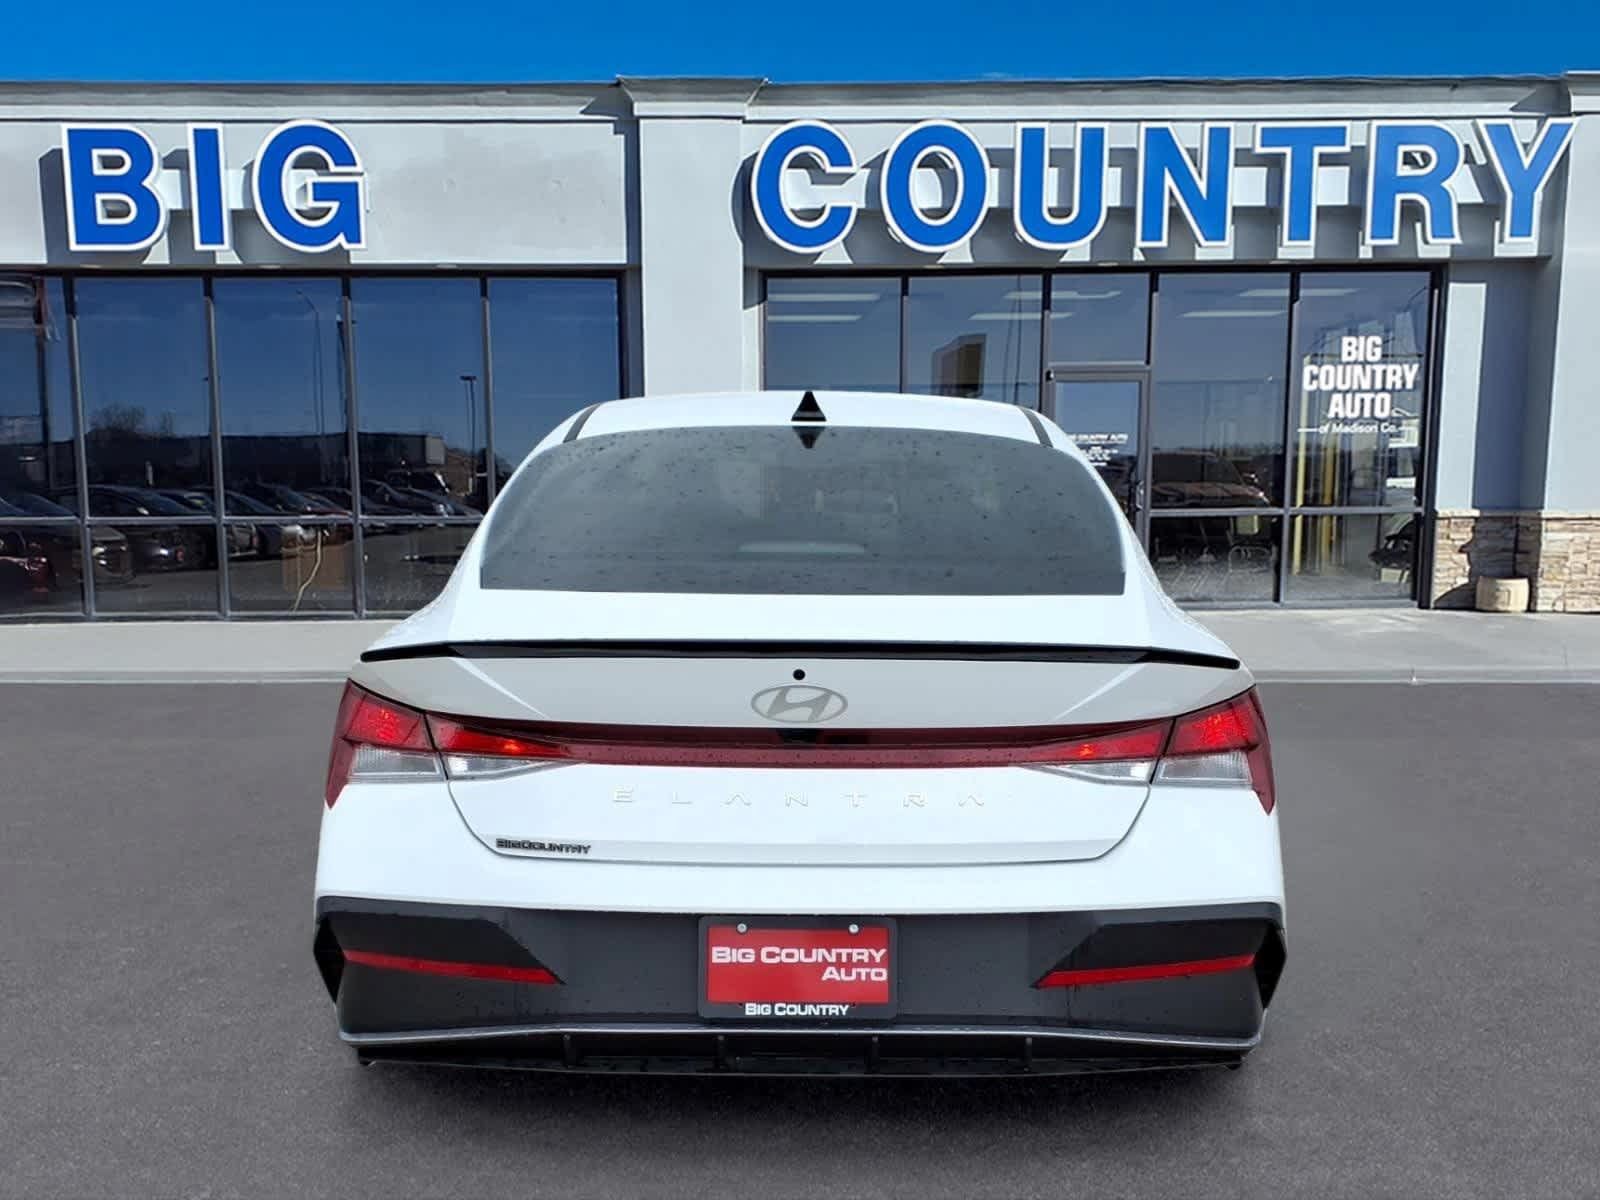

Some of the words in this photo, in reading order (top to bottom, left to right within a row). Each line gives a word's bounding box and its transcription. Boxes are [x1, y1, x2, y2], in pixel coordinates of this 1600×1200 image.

[62, 119, 367, 253] BIG
[750, 117, 1574, 255] COUNTRY
[1341, 335, 1383, 362] BIG
[1303, 363, 1419, 391] COUNTRY
[1328, 392, 1392, 419] AUTO
[1332, 422, 1379, 433] Madison
[612, 785, 986, 807] ELANTRA
[711, 946, 756, 963] BIG
[760, 946, 887, 963] COUNTRY
[821, 966, 887, 981] AUTO
